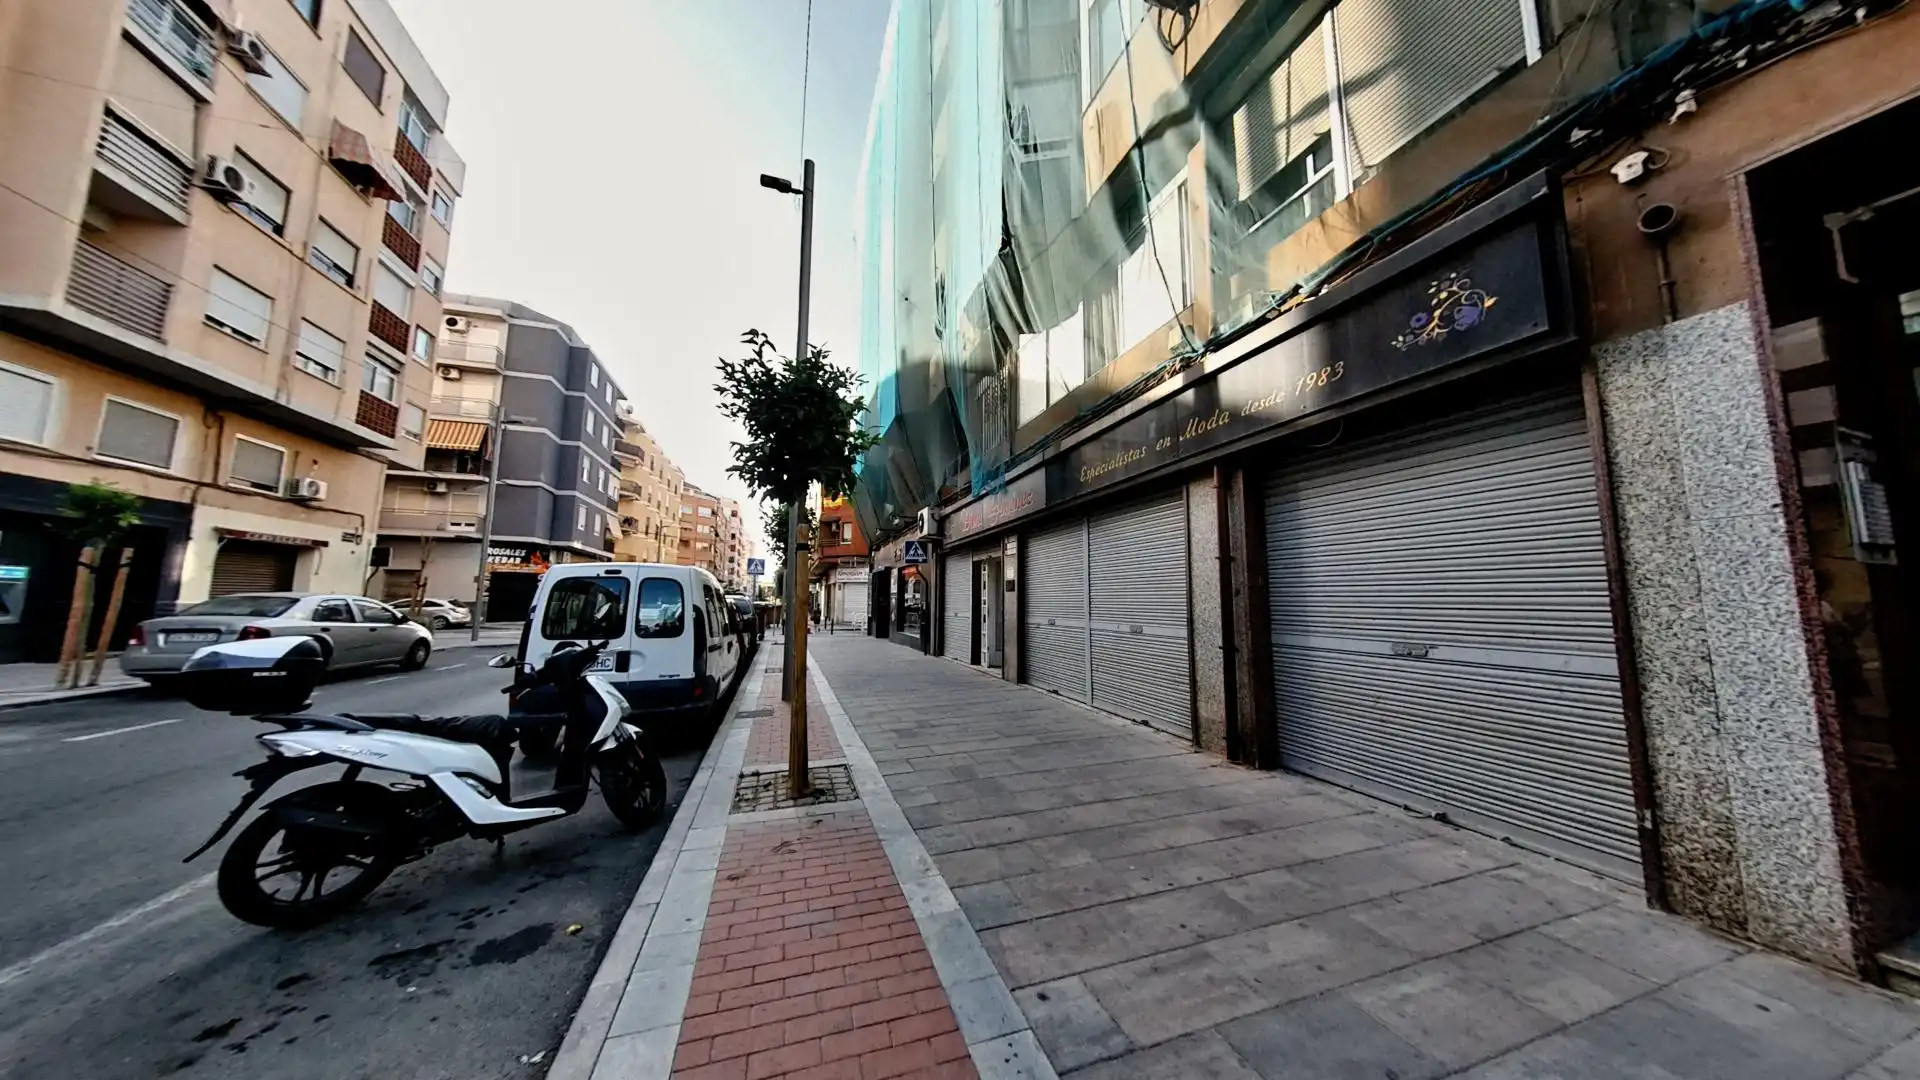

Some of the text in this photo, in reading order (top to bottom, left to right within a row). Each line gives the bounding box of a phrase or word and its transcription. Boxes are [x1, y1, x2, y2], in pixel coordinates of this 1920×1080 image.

[1080, 361, 1344, 482] Especialistas en Moda desde 1983
[487, 547, 527, 557] ROSALES
[487, 556, 521, 565] KEBAB
